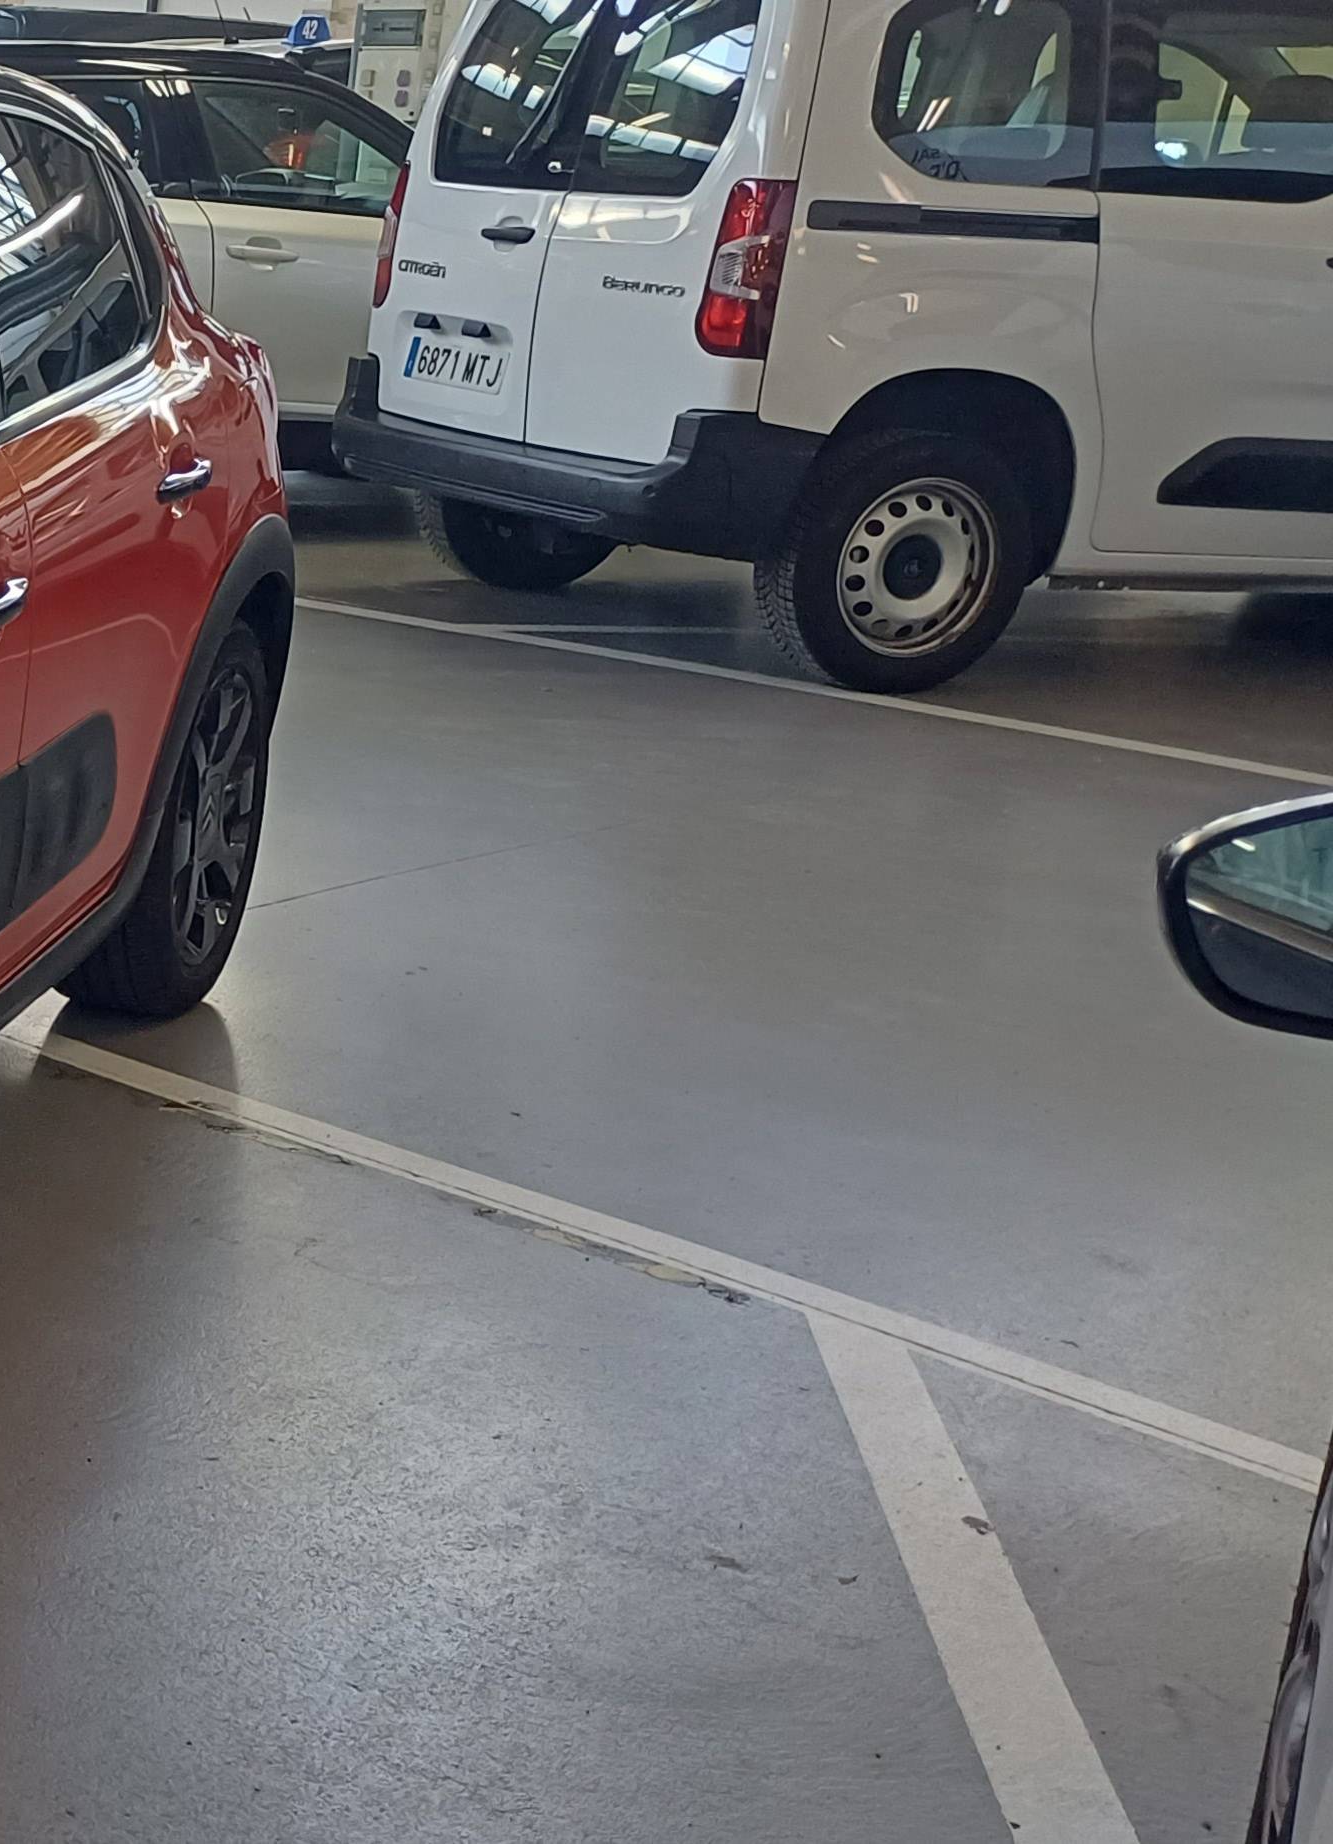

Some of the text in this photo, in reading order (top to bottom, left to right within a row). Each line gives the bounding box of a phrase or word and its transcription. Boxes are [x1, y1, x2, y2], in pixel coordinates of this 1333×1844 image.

[301, 19, 319, 40] 42
[417, 345, 503, 388] 6871 MTJ
